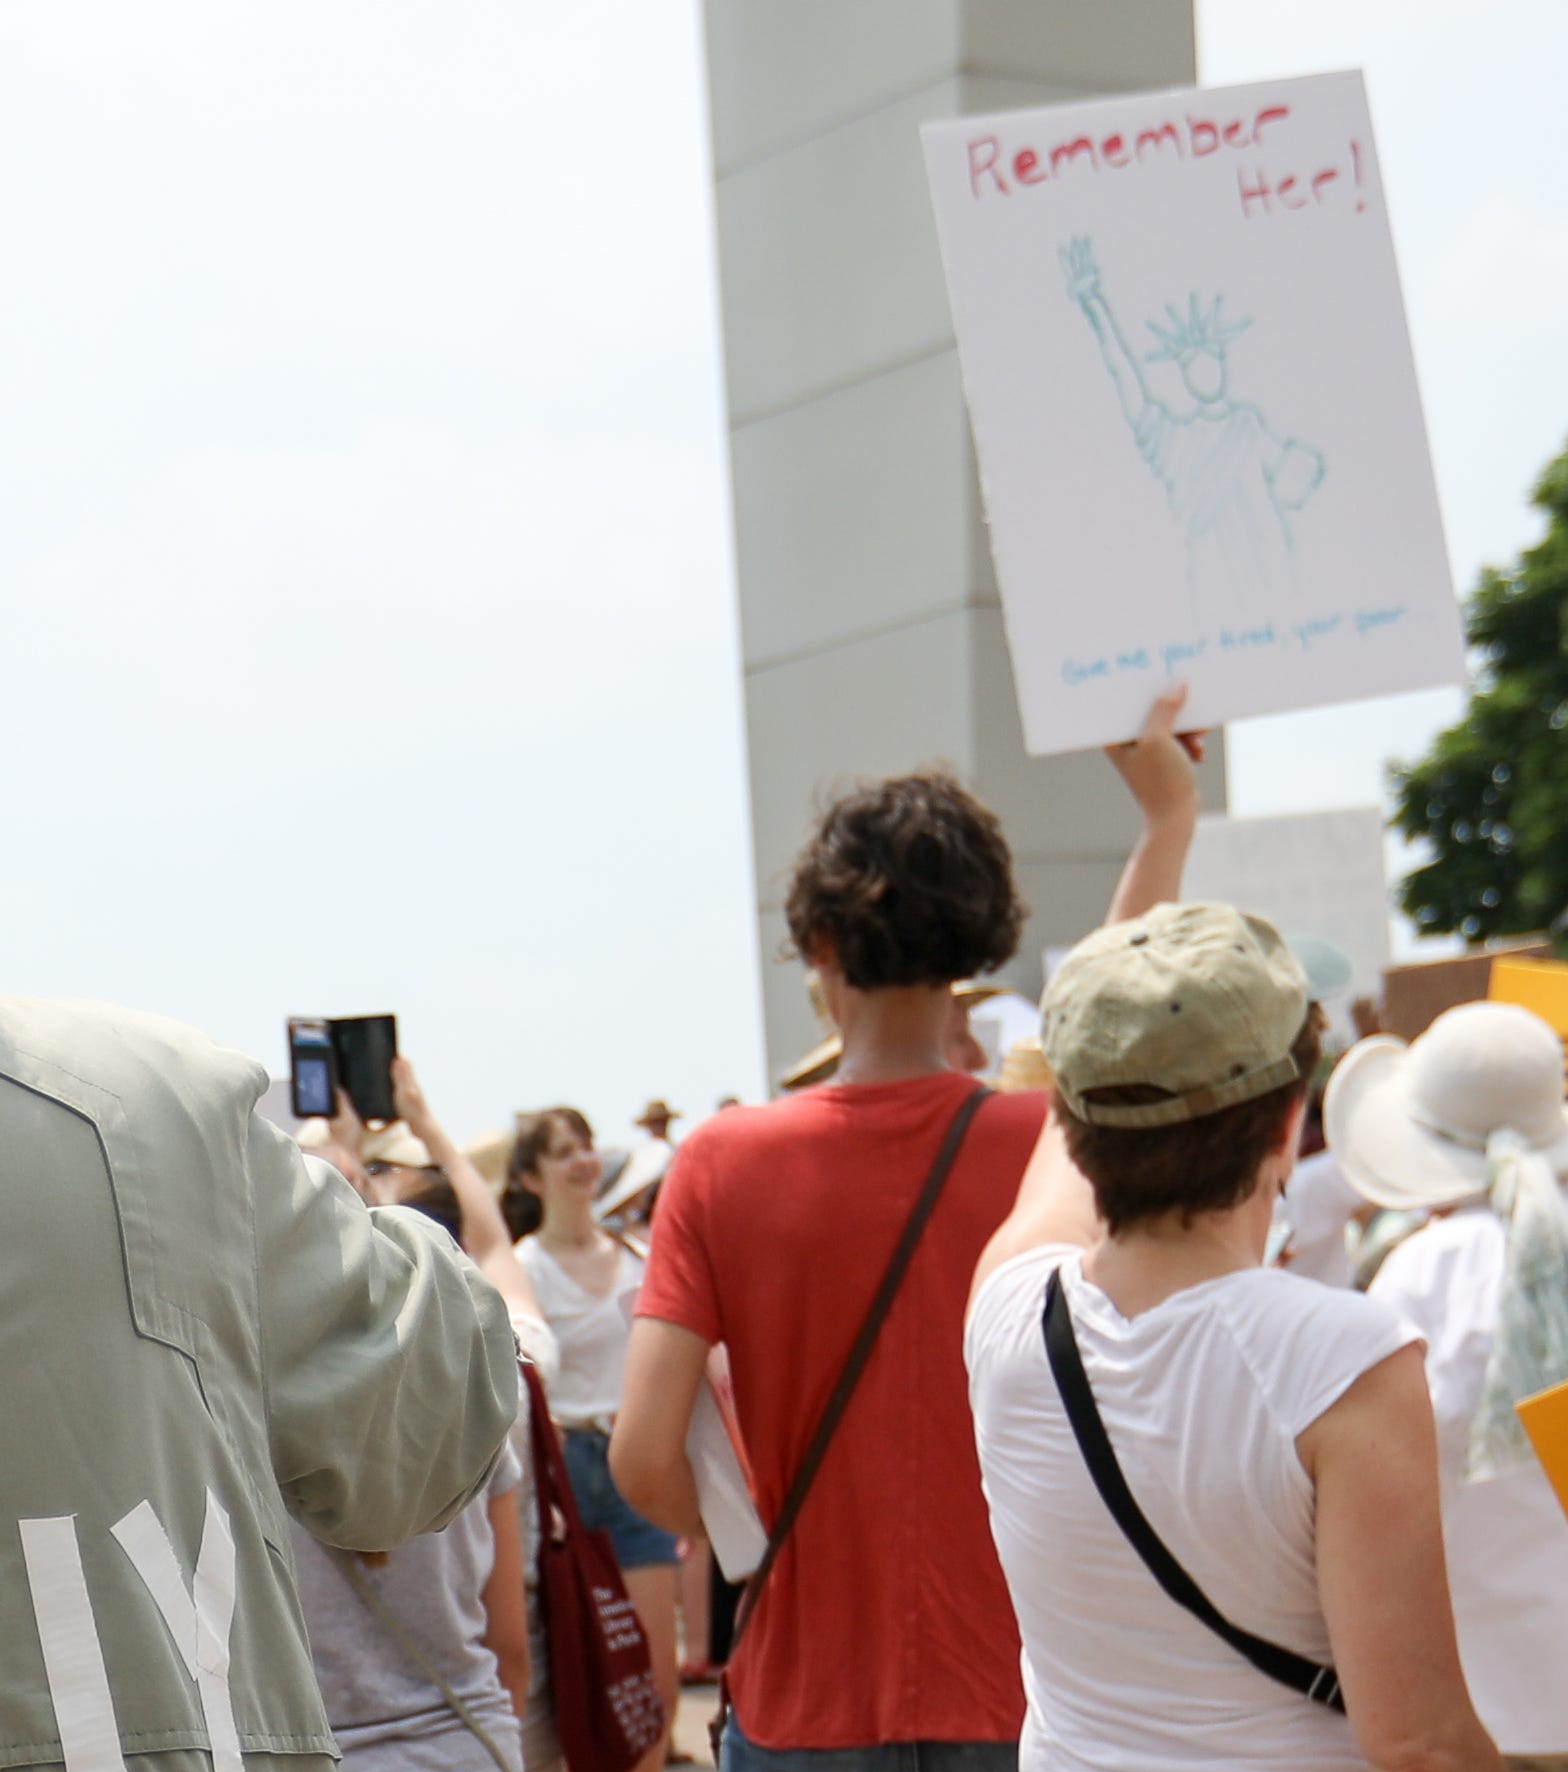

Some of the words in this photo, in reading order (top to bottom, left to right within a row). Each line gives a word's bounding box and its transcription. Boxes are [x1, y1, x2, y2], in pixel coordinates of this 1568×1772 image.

[967, 106, 1290, 200] Remember
[1237, 141, 1367, 219] Her!
[1116, 646, 1151, 669] me
[1158, 637, 1208, 676] your
[1291, 612, 1342, 649] your
